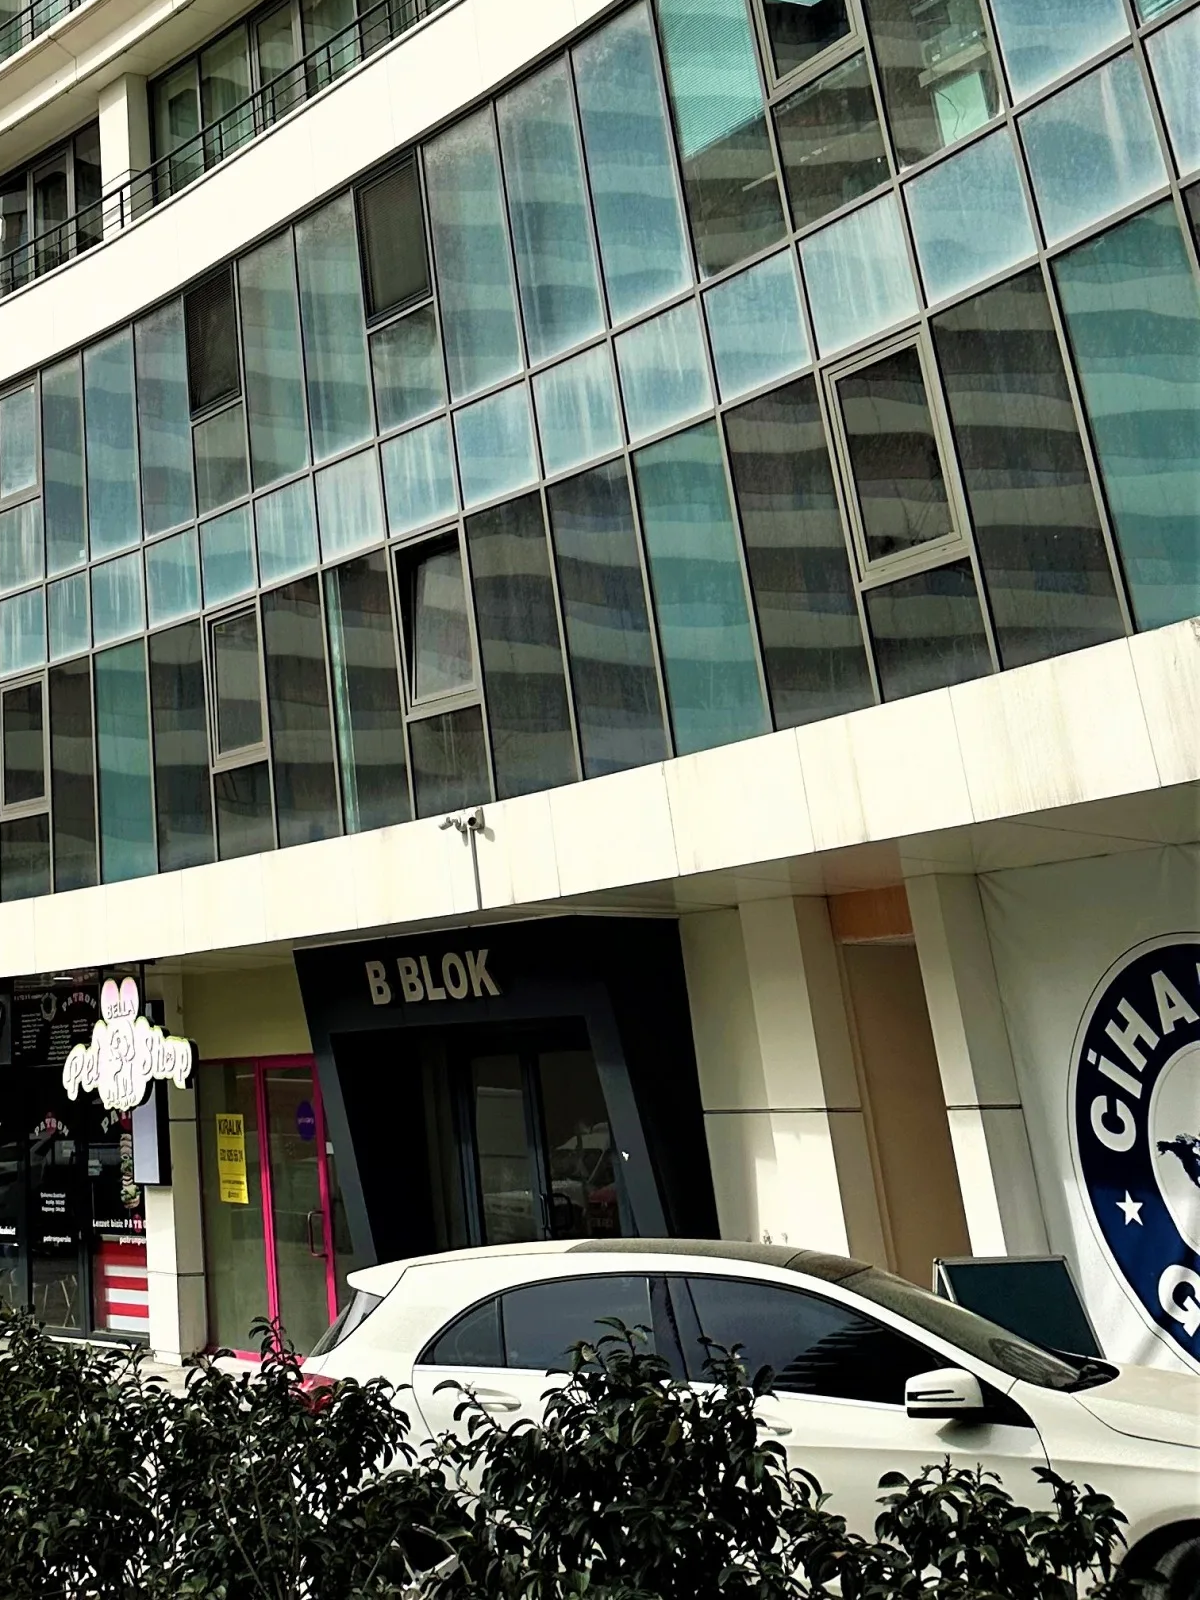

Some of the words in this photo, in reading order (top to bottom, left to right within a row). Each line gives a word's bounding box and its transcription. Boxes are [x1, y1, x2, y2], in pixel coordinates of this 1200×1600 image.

[365, 960, 392, 1006] B
[396, 949, 501, 1003] BLOK
[106, 999, 136, 1020] BELLA
[140, 1035, 190, 1082] Shop
[1088, 962, 1200, 1152] CİHA
[34, 1117, 69, 1137] PATRON
